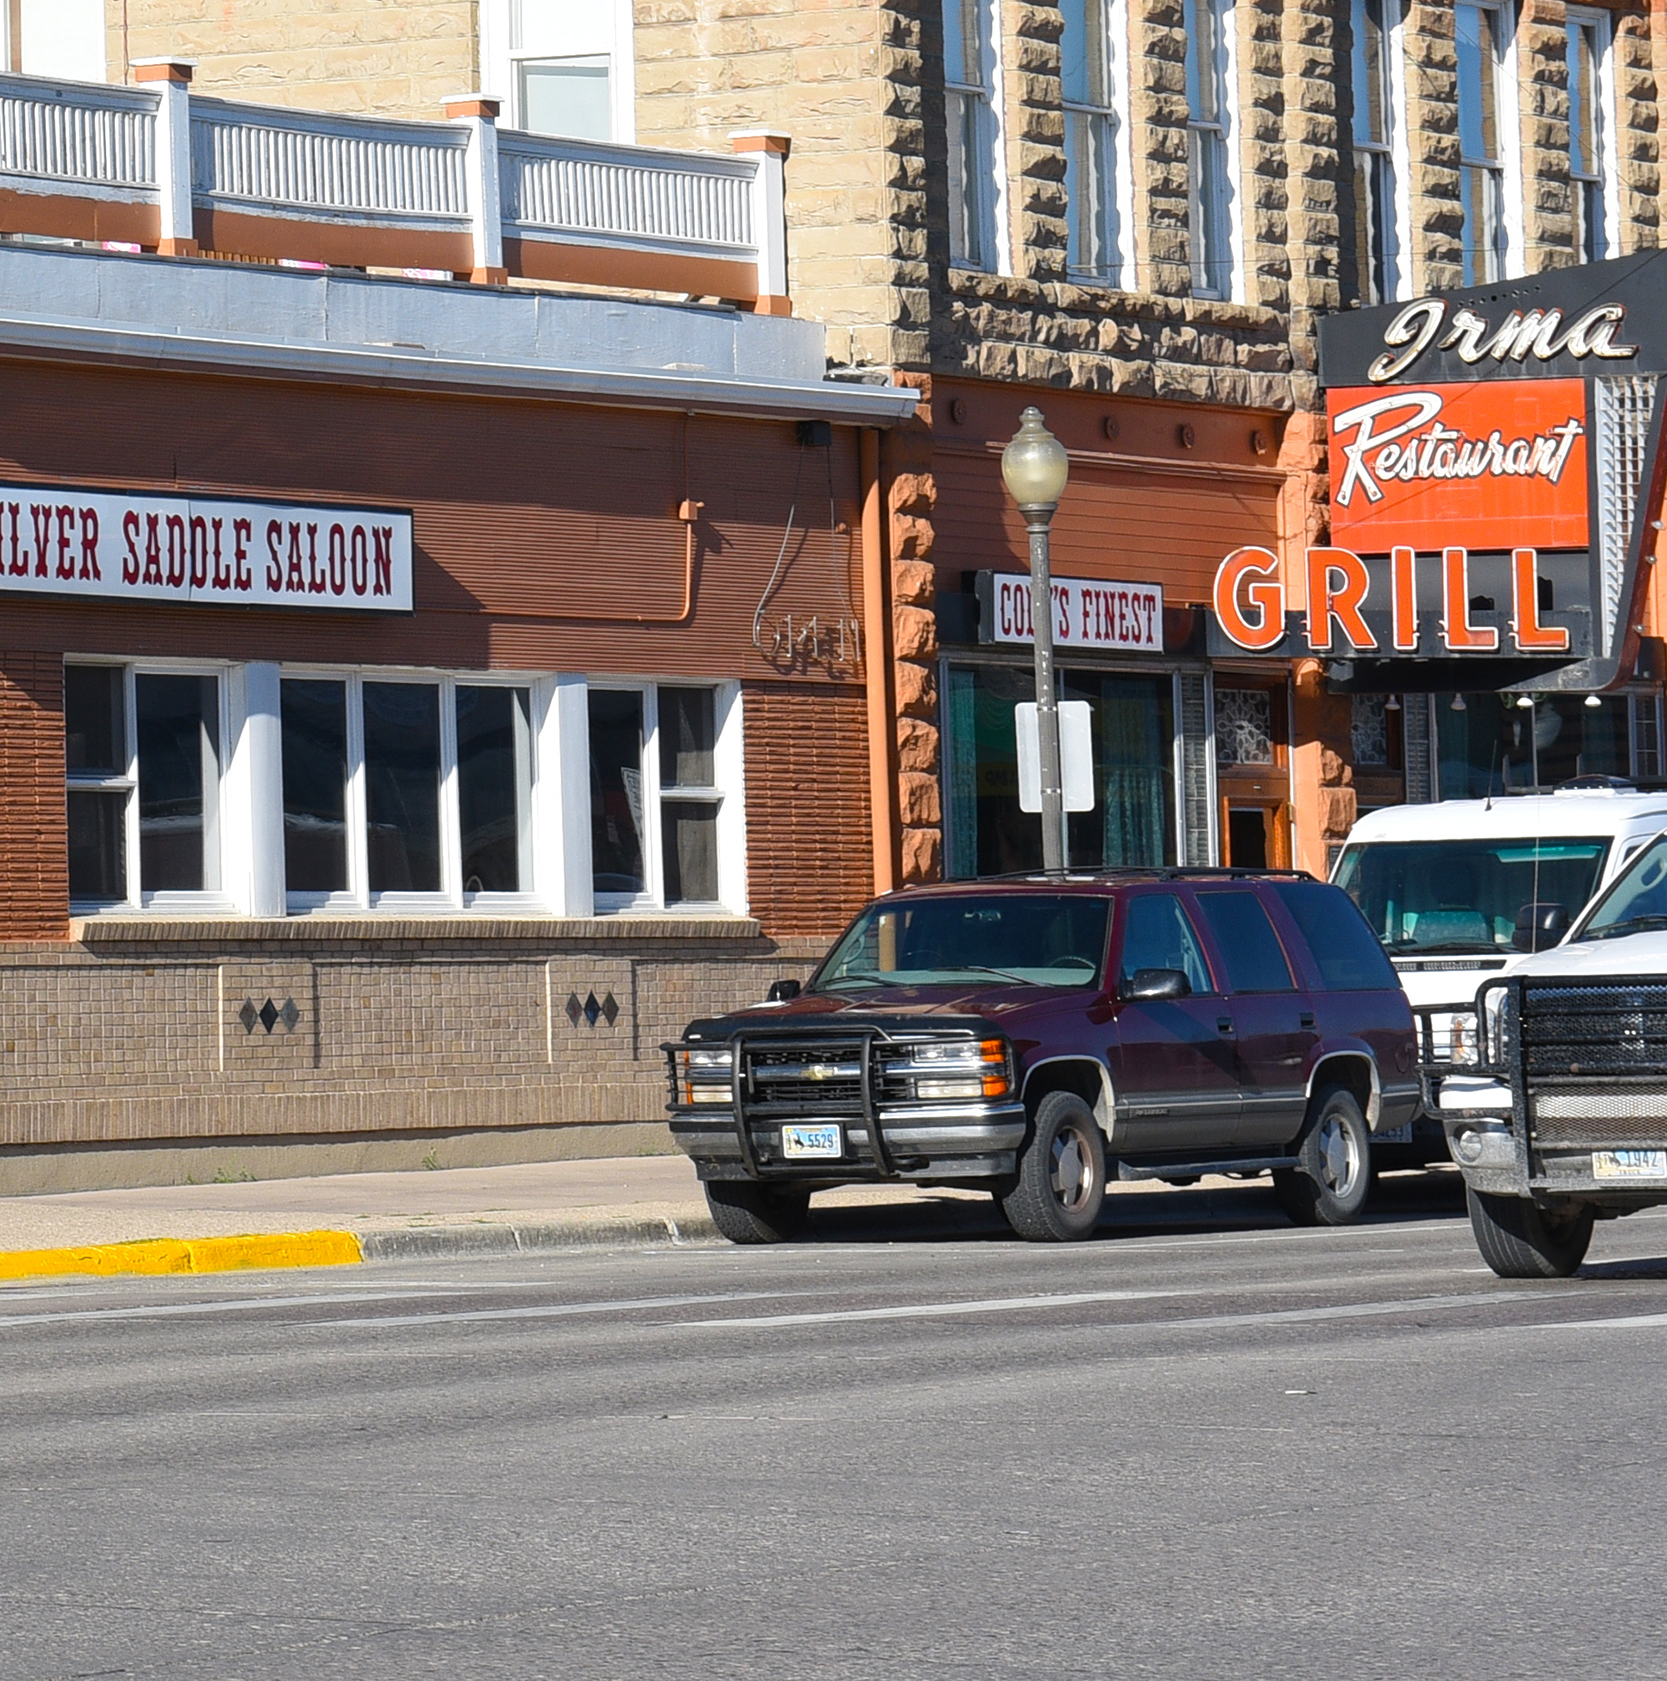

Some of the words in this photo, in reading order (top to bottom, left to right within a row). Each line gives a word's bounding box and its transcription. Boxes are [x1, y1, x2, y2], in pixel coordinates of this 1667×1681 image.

[1369, 297, 1641, 384] Irma
[1333, 391, 1583, 507] Restaurant
[122, 509, 253, 592] SADDLE
[266, 518, 394, 597] SALOON
[1000, 582, 1070, 639] CO'S
[1081, 587, 1157, 645] FINEST
[1213, 546, 1570, 651] GRILL
[808, 1133, 834, 1149] 5529
